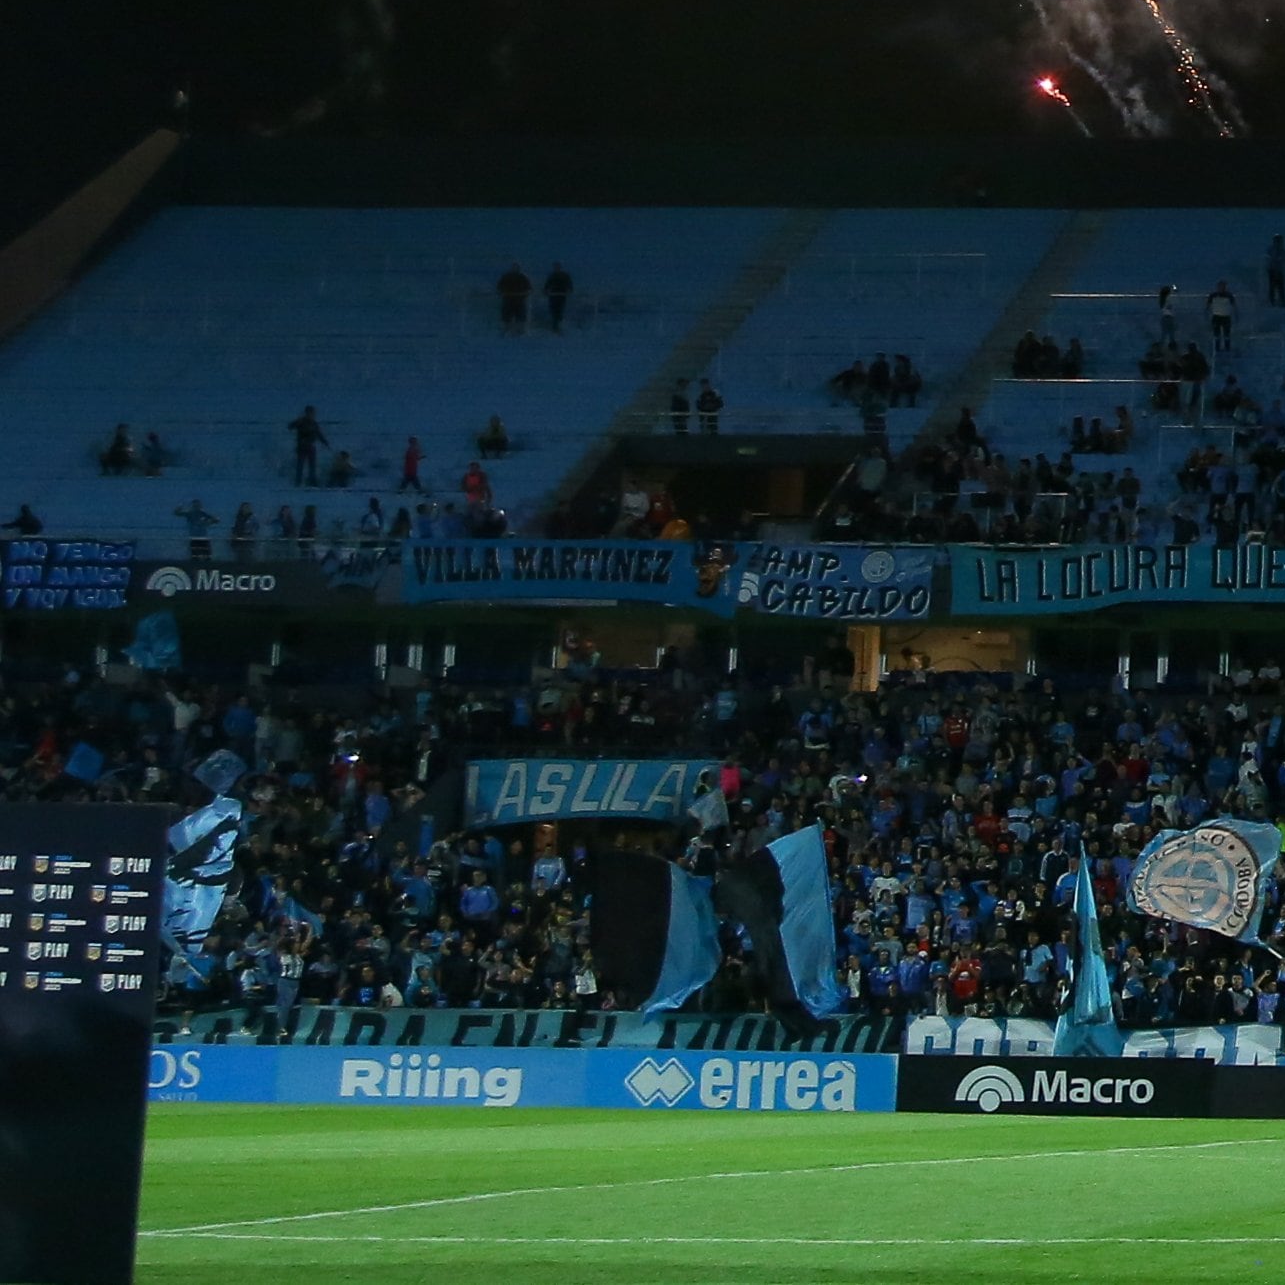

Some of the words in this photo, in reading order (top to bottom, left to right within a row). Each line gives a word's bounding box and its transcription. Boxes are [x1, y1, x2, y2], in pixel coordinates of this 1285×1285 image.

[196, 569, 276, 591] Macro
[413, 546, 501, 584] VILLA
[513, 546, 673, 585] MARTINEZ
[976, 557, 1019, 603] LA
[1038, 544, 1189, 602] LOCURA
[761, 579, 931, 619] CABILDO
[340, 1054, 524, 1107] Riiing
[698, 1058, 856, 1112] errea
[1031, 1070, 1156, 1105] Macro
